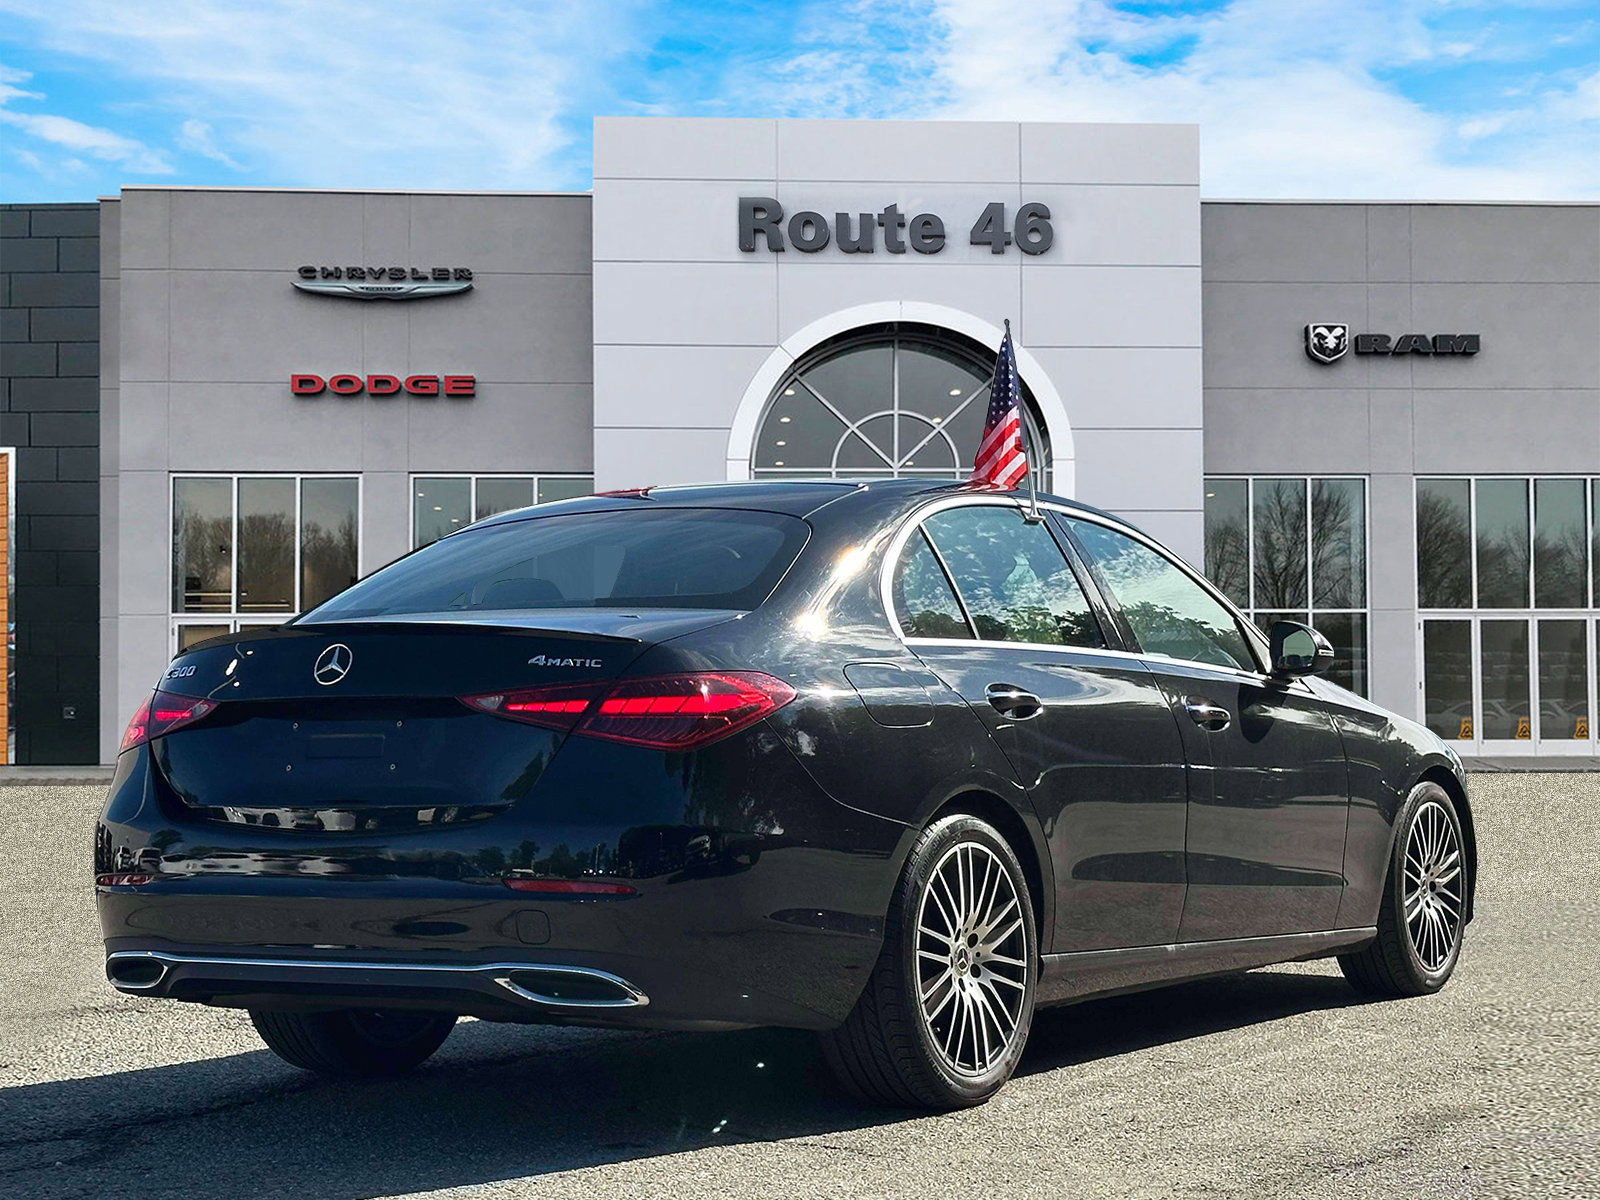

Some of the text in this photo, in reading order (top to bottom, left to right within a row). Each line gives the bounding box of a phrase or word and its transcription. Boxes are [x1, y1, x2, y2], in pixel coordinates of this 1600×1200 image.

[738, 196, 1054, 255] Route 46
[297, 265, 473, 281] CHRYSLER
[1354, 333, 1481, 356] RAM
[290, 374, 477, 398] DODGE
[527, 654, 603, 668] 4MATIC
